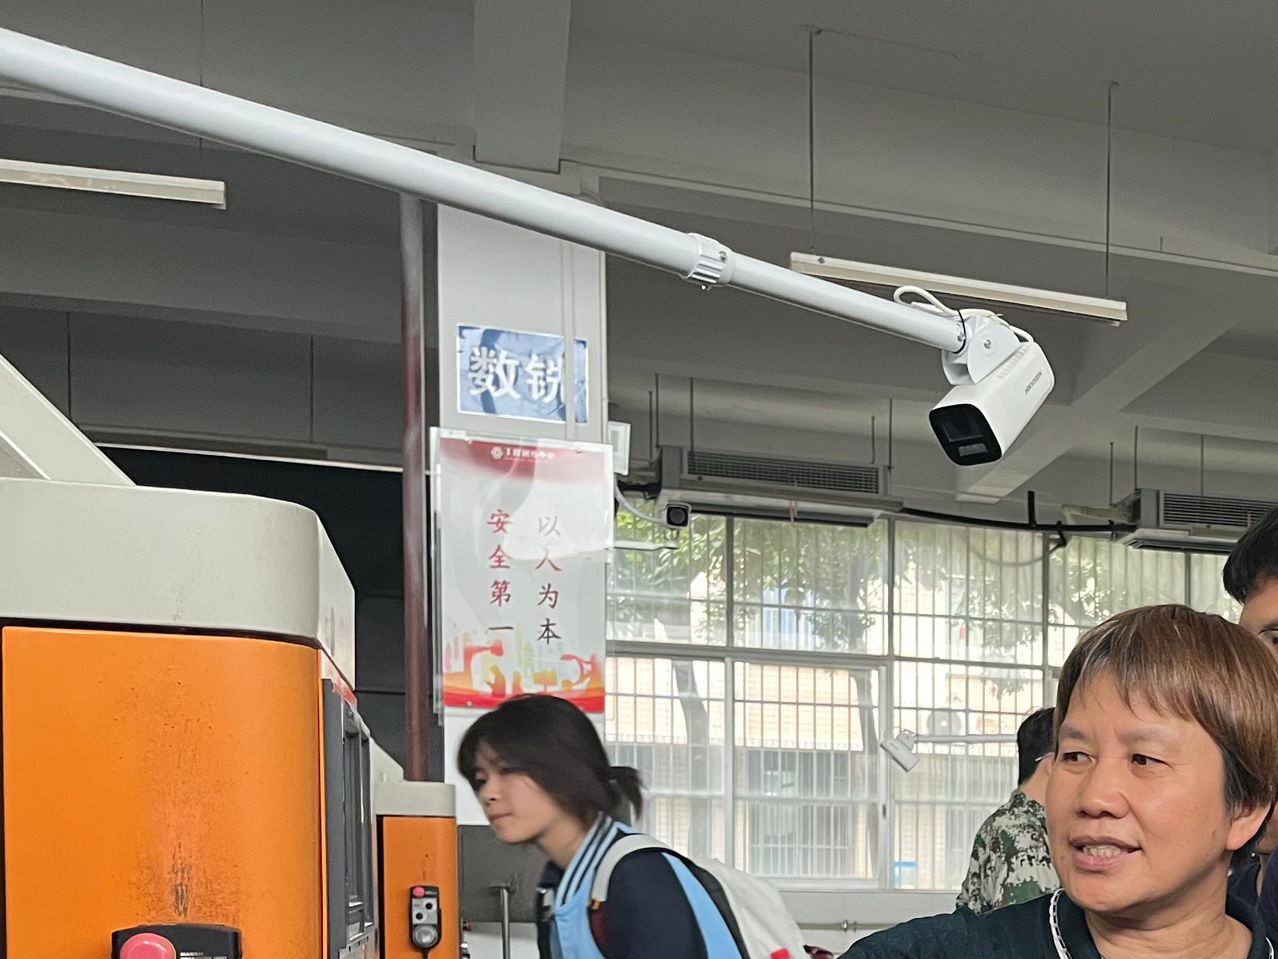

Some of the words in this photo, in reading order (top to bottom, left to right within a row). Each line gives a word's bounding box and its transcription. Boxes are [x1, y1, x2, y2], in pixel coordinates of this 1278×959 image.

[487, 508, 514, 632] 安全第一
[535, 515, 563, 645] 以人为本
